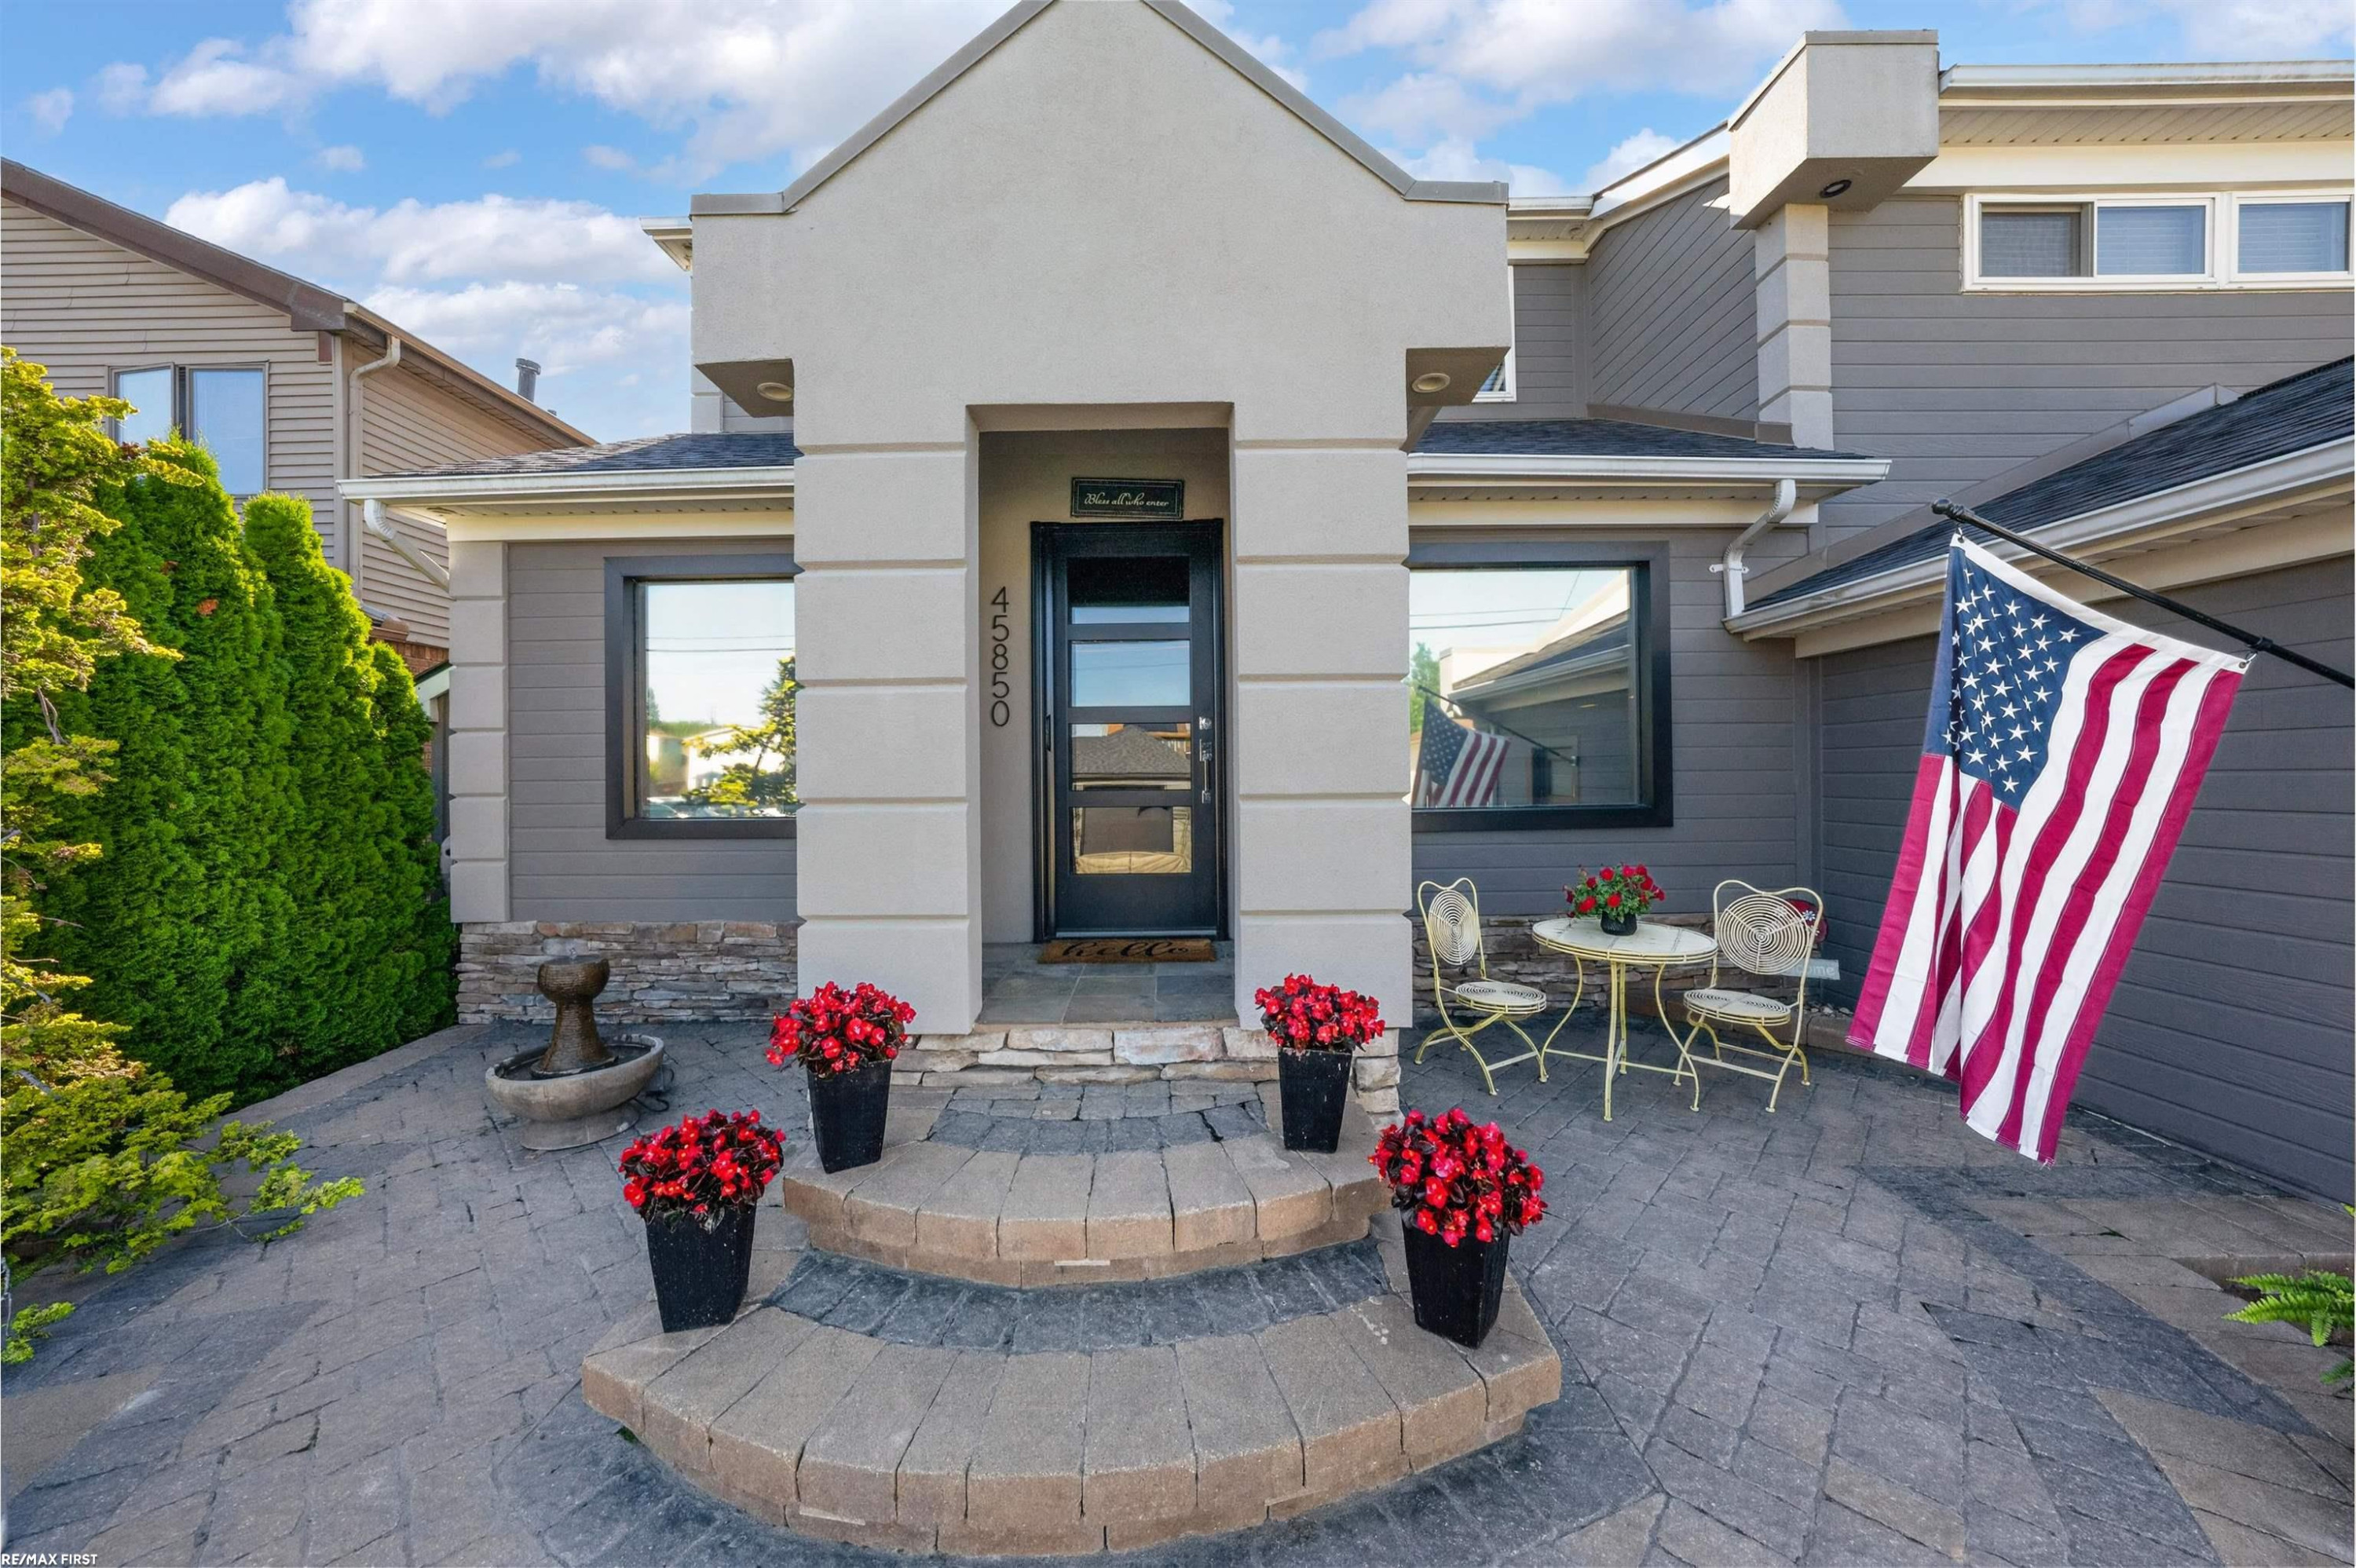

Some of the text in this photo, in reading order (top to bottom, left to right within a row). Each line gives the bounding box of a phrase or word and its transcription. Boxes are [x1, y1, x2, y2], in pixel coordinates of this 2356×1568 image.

[1085, 492, 1110, 504] Bless
[1111, 492, 1131, 505] all
[1125, 492, 1144, 506] who
[991, 586, 1010, 727] 45850
[1062, 941, 1201, 957] hello
